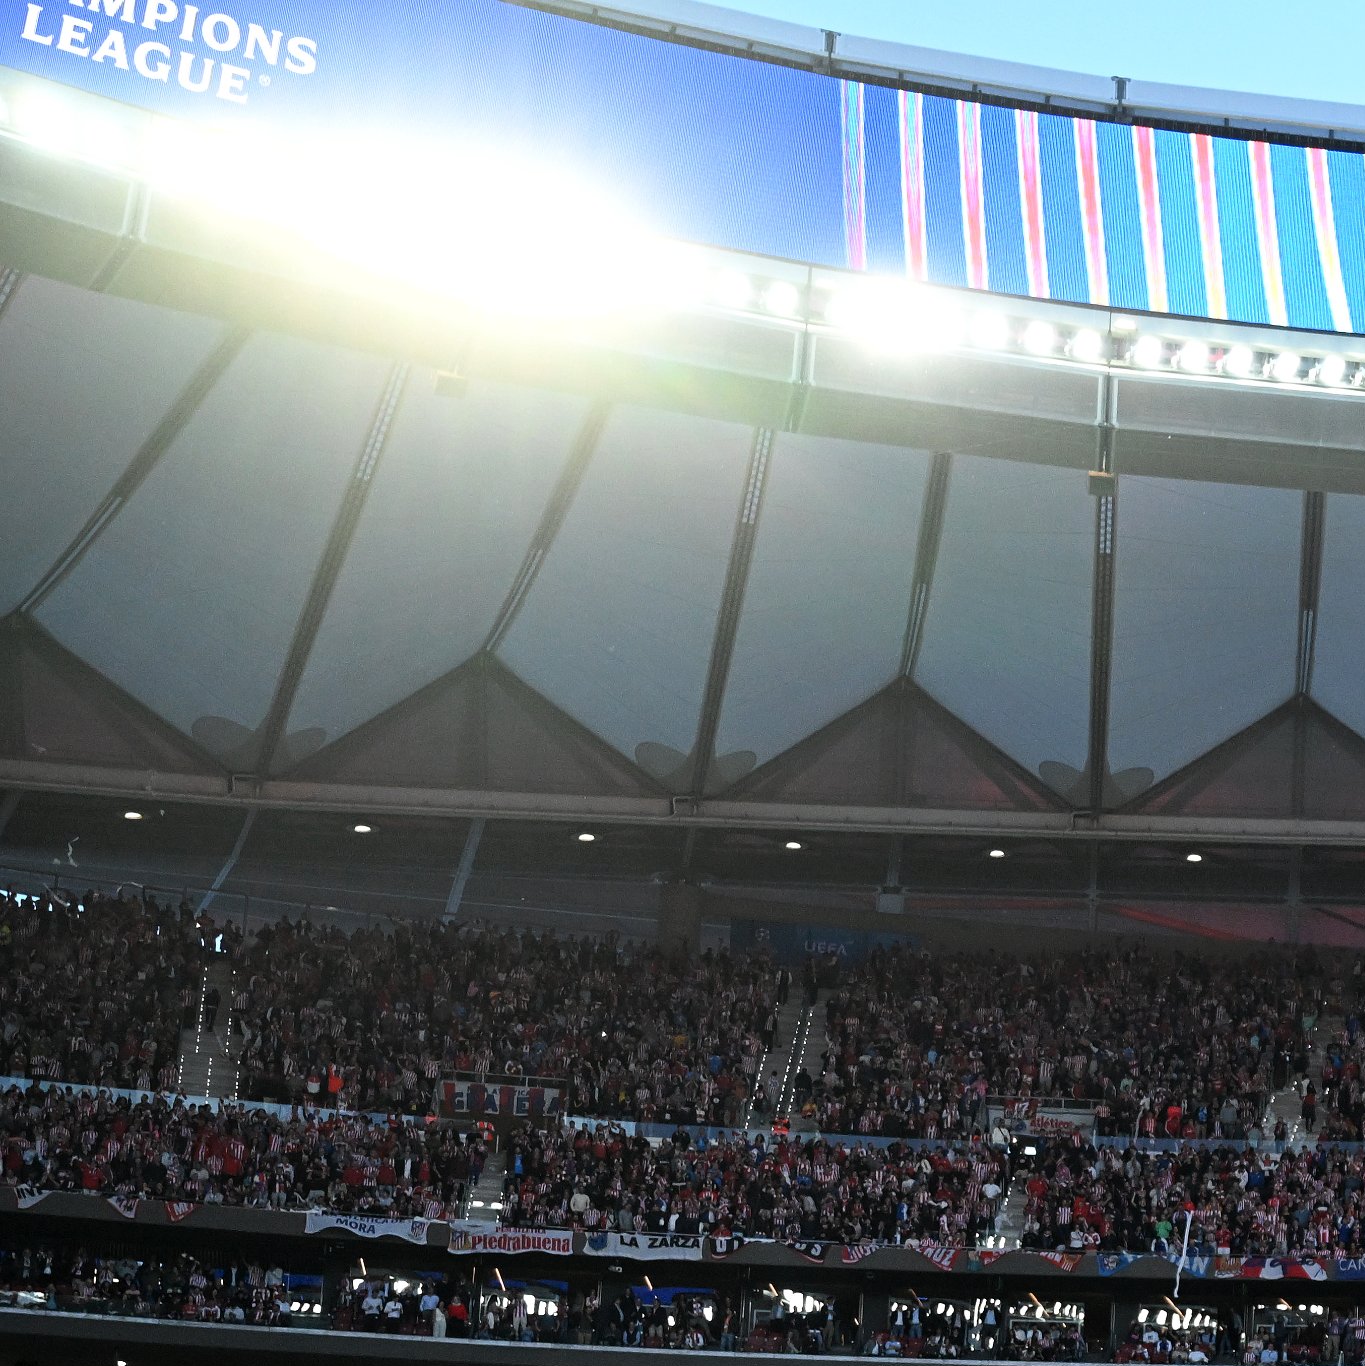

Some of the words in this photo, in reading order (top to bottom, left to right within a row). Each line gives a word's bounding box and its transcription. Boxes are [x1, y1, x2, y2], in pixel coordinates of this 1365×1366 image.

[20, 2, 252, 105] LEAGUE
[804, 941, 847, 956] UEFA
[336, 1217, 375, 1234] MORA
[471, 1232, 570, 1253] Piedrabuena
[619, 1236, 638, 1248] LA
[648, 1237, 701, 1249] ZARZA
